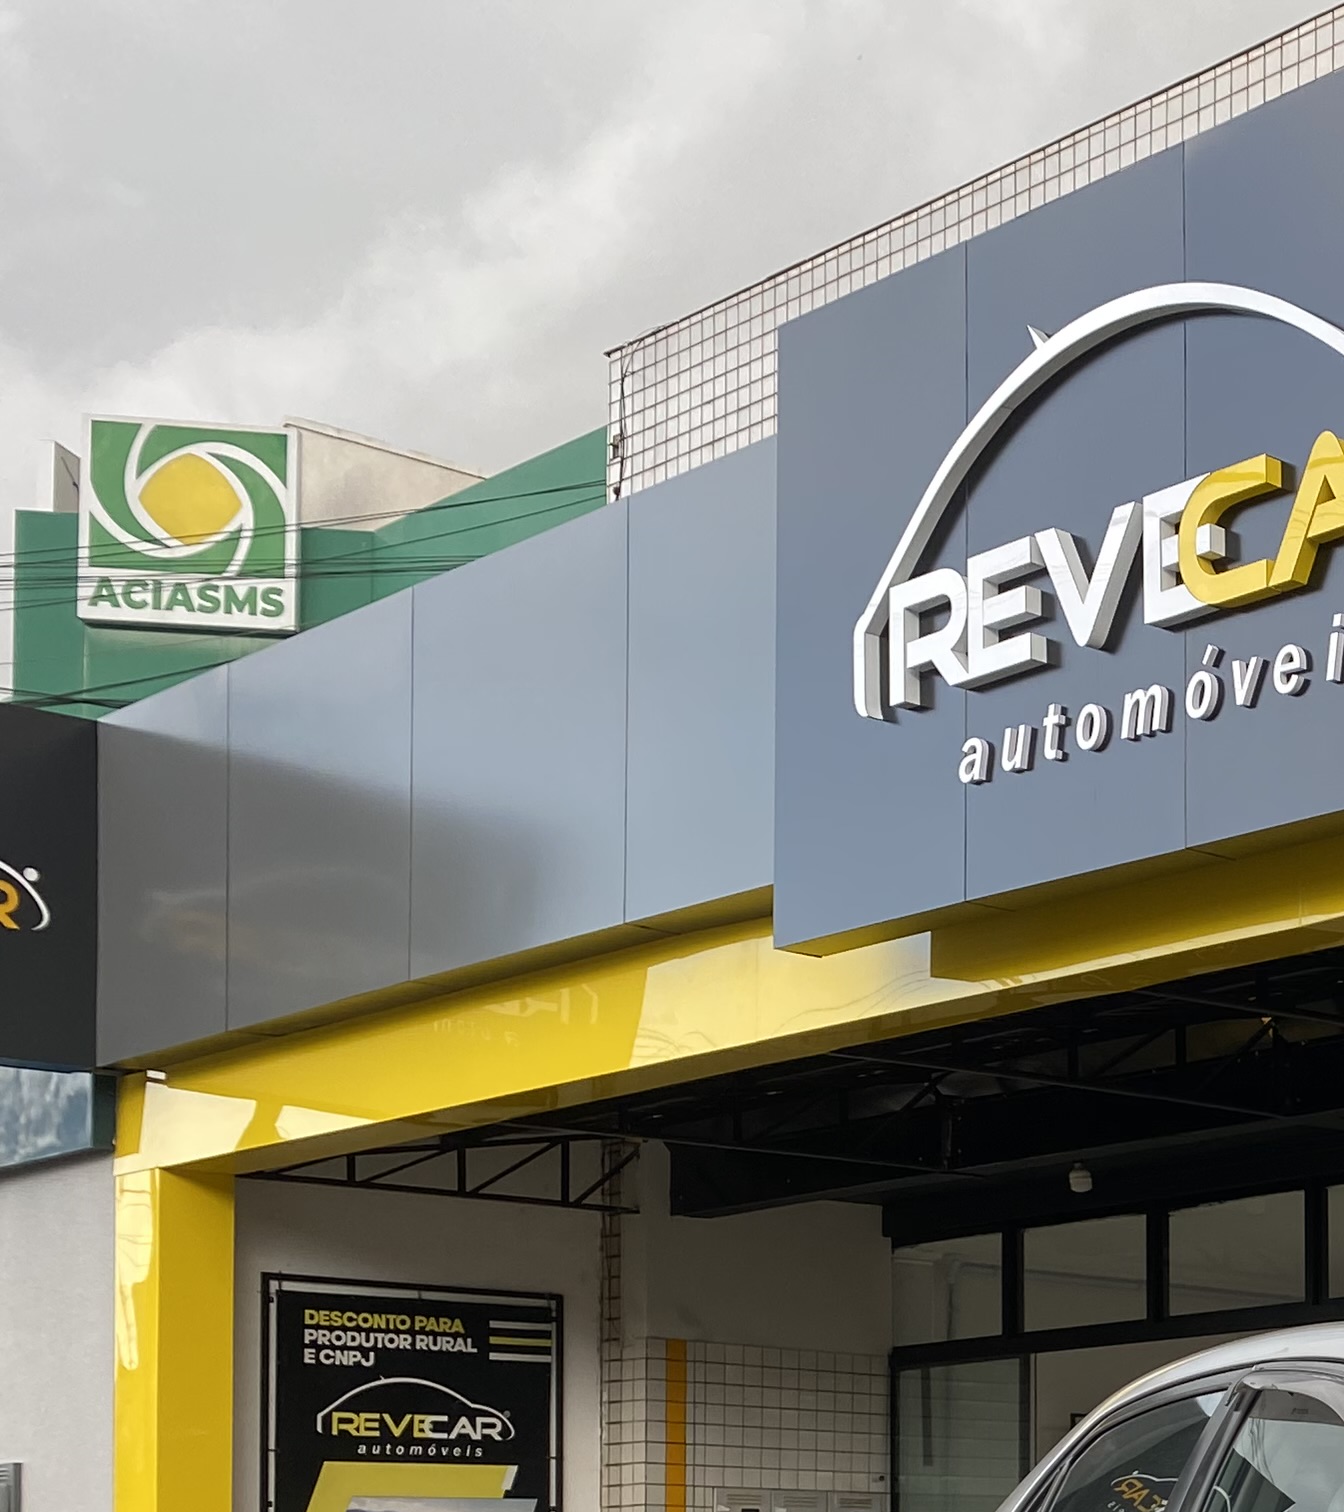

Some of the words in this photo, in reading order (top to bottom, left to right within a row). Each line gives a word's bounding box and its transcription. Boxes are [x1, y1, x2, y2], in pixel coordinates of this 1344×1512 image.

[87, 576, 285, 618] ACIASMS
[304, 1309, 411, 1331] DESCONTO
[414, 1315, 465, 1334] PARA
[304, 1329, 411, 1350] PRODUTOR
[415, 1334, 478, 1353] RURAL
[304, 1349, 316, 1364] E
[319, 1349, 376, 1367] CNPJ
[331, 1411, 503, 1440] REVECAR
[357, 1443, 483, 1457] automóveis
